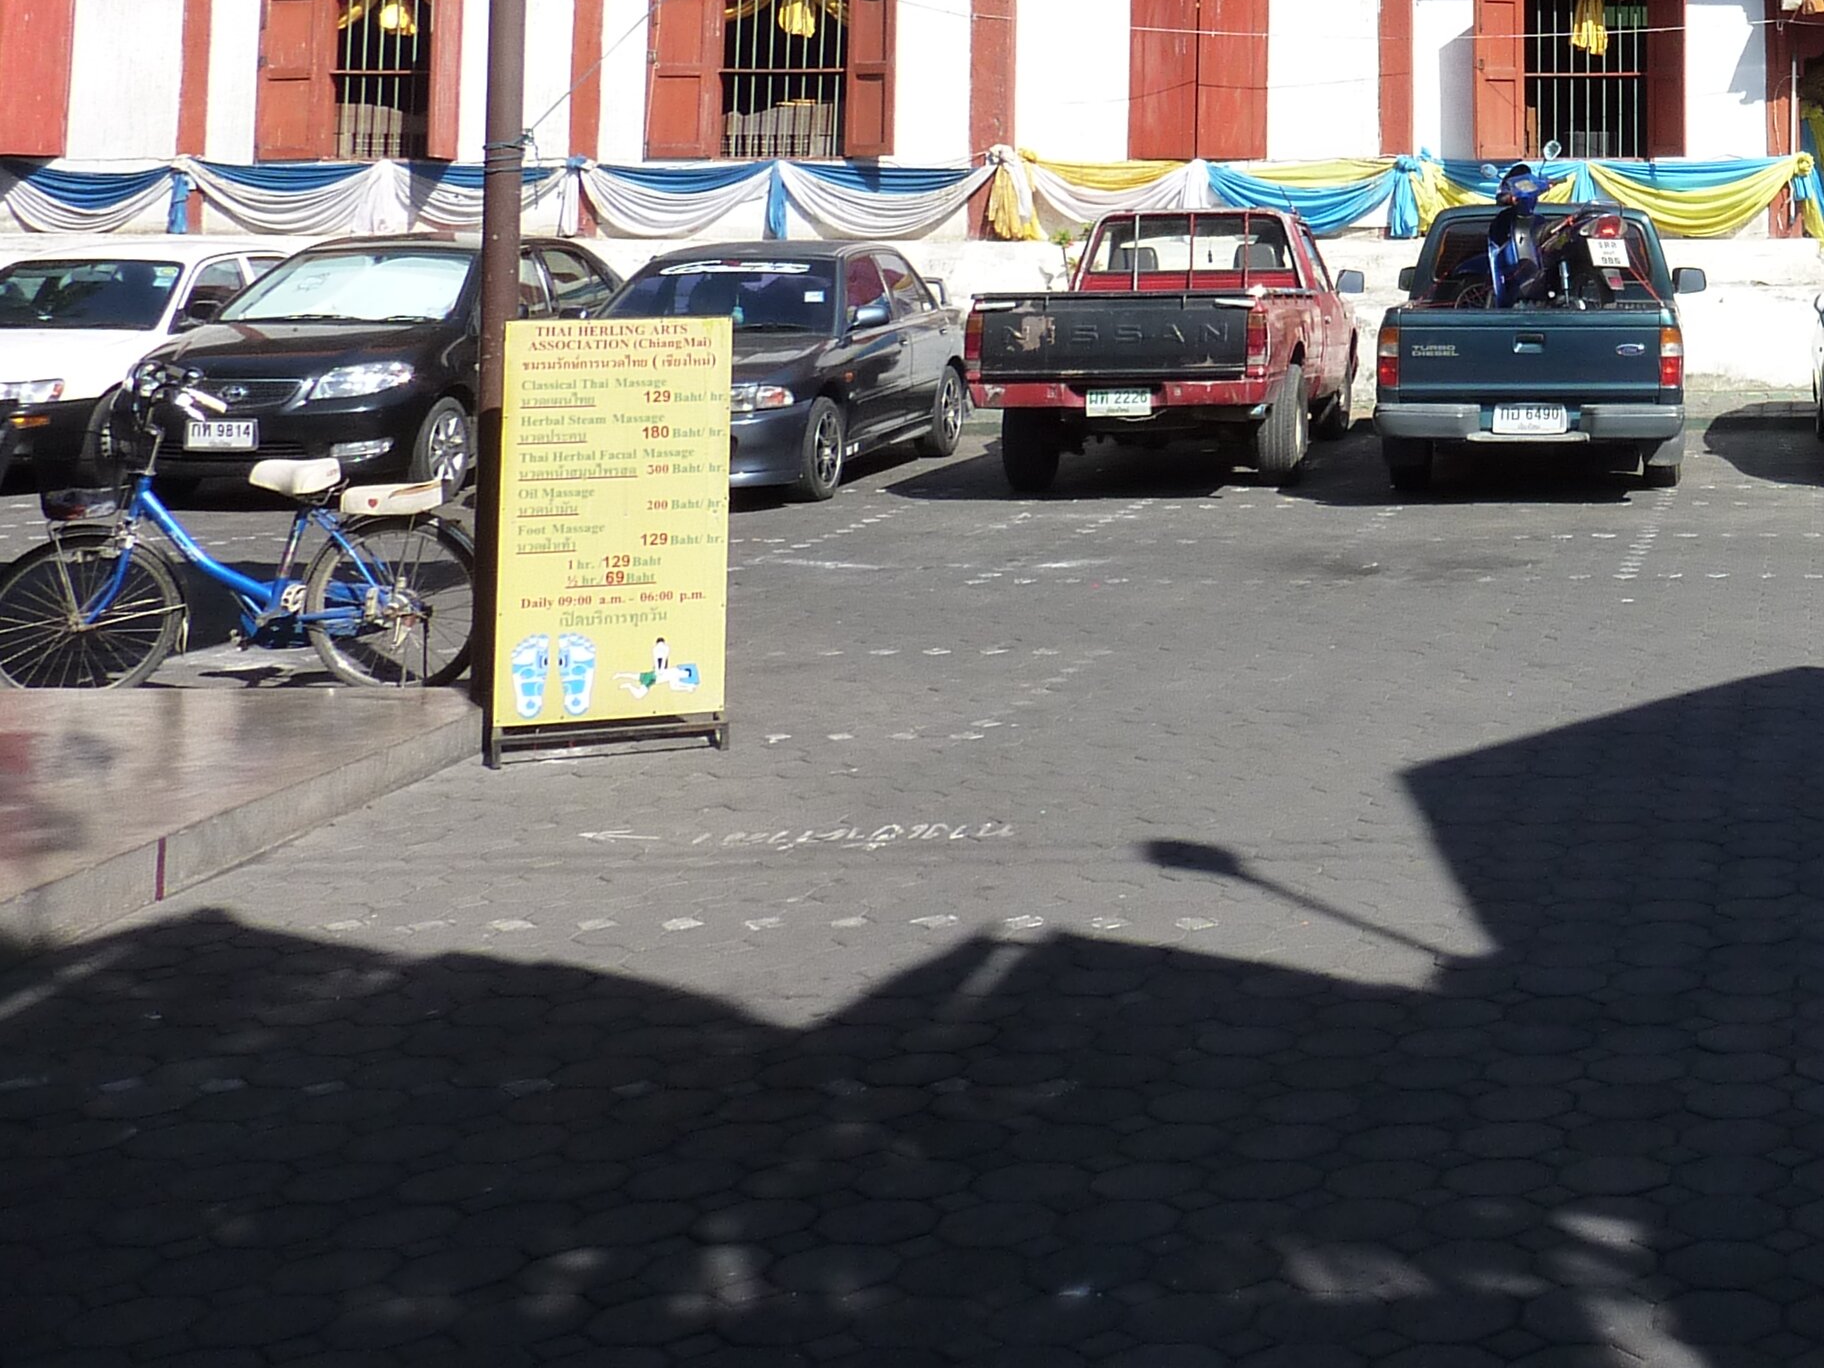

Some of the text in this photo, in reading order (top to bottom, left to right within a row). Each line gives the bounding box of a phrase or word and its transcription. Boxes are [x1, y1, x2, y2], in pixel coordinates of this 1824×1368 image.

[535, 325, 573, 337] THAI
[650, 324, 688, 335] ARTS
[1003, 320, 1229, 348] NISSAN
[528, 338, 629, 351] ASSOCIATION
[521, 377, 668, 391] Classical Thai Massage
[643, 390, 671, 403] 129
[1114, 390, 1148, 404] 2226
[1525, 406, 1560, 420] 6490
[521, 413, 665, 427] Herbal Steam Massage
[217, 423, 251, 437] 9814
[642, 426, 670, 439] 180
[520, 447, 695, 464] Thai Herbal Facial Massage
[518, 487, 595, 499] Oil Massage
[647, 499, 668, 511] 200
[518, 523, 605, 536] Foot Massage
[641, 533, 668, 546] 129
[633, 556, 661, 567] Baht
[627, 572, 655, 584] Baht
[520, 598, 554, 610] Daily
[558, 595, 592, 607] 09:00
